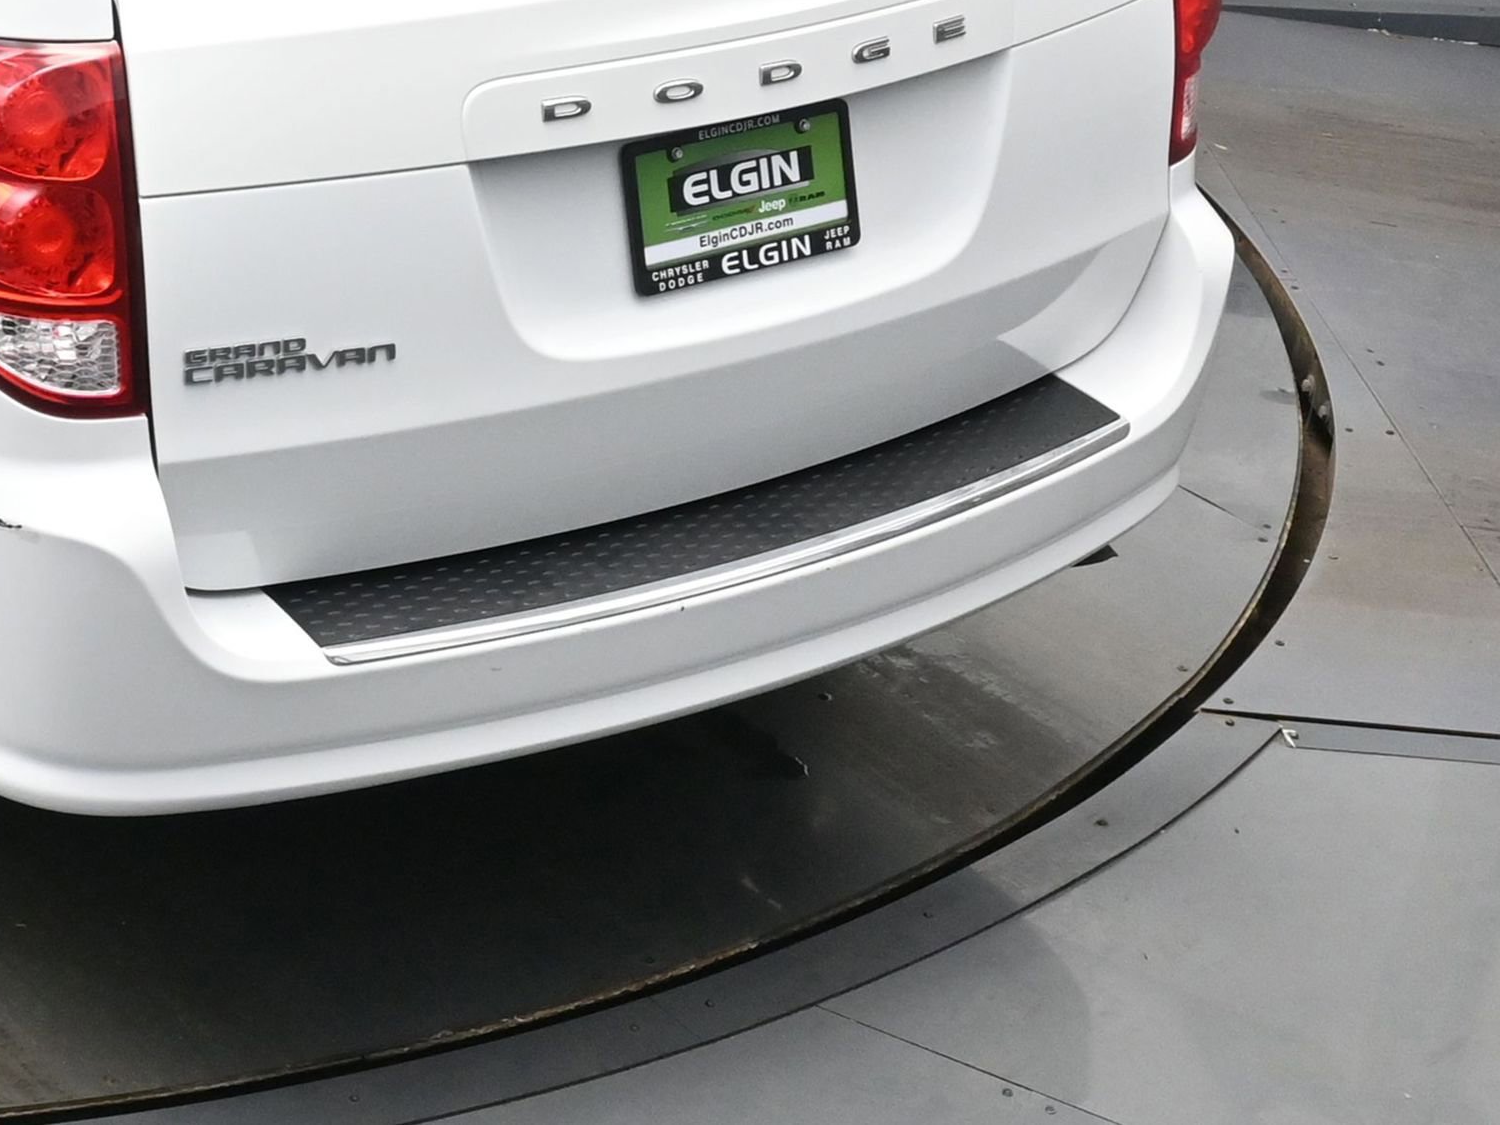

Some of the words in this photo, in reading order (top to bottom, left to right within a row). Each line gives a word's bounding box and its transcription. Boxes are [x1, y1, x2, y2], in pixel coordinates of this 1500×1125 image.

[542, 14, 966, 122] DODGE
[698, 114, 781, 141] ELGINCDJR.COM
[682, 150, 801, 207] ELGIN
[758, 198, 786, 213] Jeep
[699, 217, 794, 248] ElginCDJR.com
[824, 225, 850, 241] JEEP
[826, 236, 851, 251] RAM
[721, 234, 812, 275] ELGIN
[651, 259, 710, 282] CHRYSLER
[659, 273, 704, 292] DODGE
[184, 338, 306, 365] GRAND
[184, 343, 396, 385] CARAVAN
